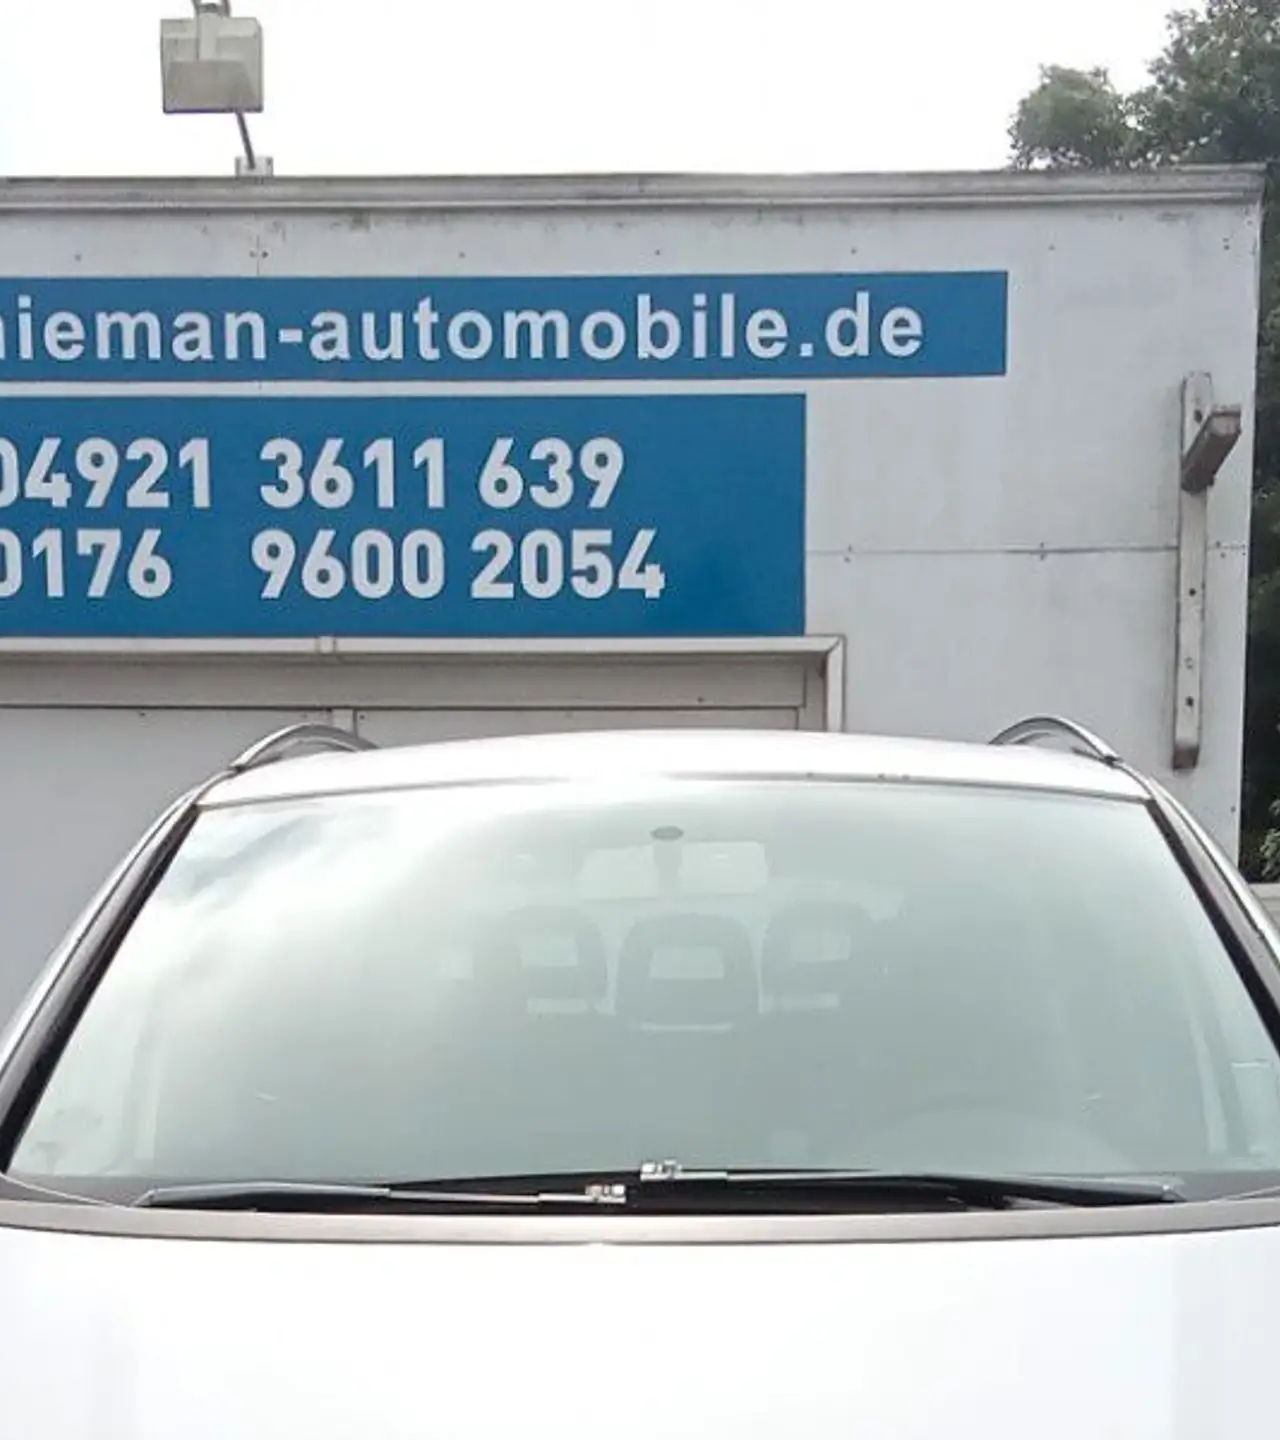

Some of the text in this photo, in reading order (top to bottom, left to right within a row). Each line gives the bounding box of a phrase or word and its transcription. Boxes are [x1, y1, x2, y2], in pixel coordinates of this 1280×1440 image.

[259, 437, 446, 508] 3611
[478, 437, 624, 507] 639
[251, 529, 446, 598] 9600
[470, 529, 667, 597] 2054
